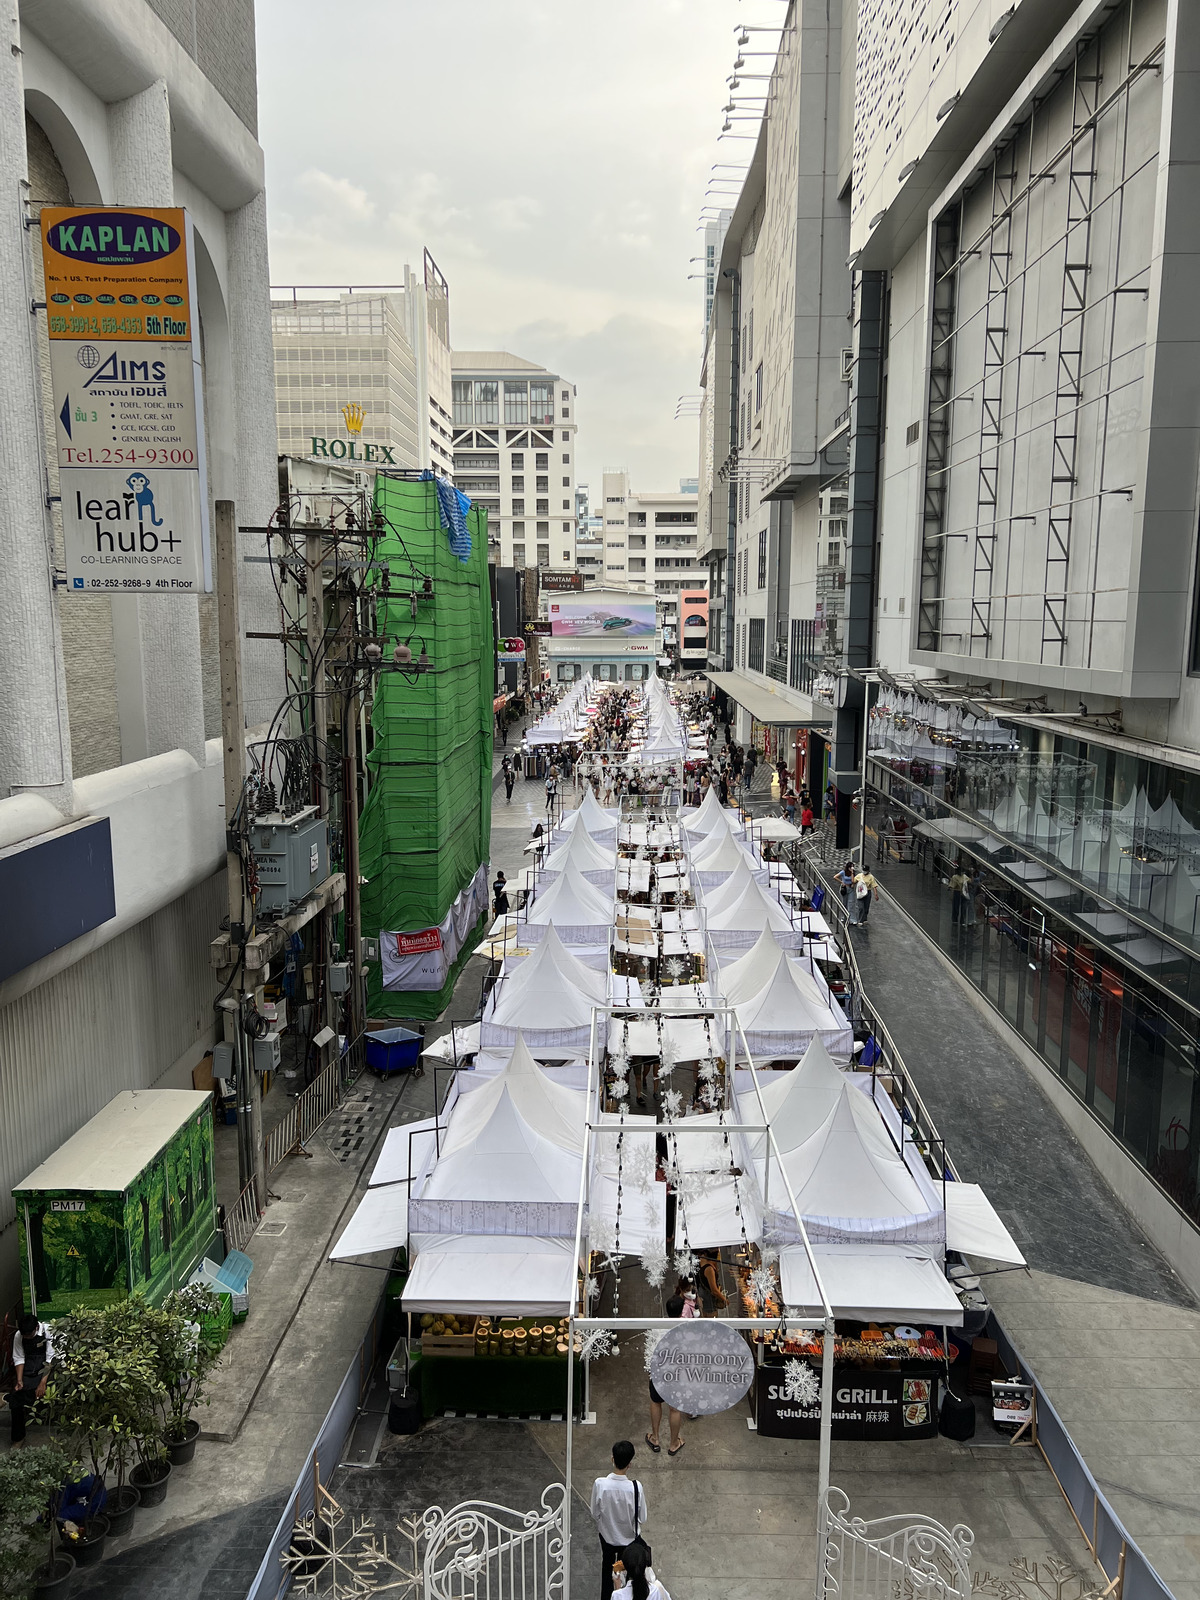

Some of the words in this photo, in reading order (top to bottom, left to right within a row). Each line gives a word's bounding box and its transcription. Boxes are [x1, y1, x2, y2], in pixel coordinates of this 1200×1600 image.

[58, 225, 170, 252] KAPLAN
[142, 295, 158, 303] SAT
[101, 317, 142, 334] 658-4353
[146, 315, 161, 335] 5th
[163, 316, 186, 336] Floor
[83, 351, 166, 388] AIMS
[89, 388, 128, 397] สถาบัน
[131, 384, 167, 397] เอมส์
[75, 406, 87, 422] ชั้น
[92, 411, 98, 422] 3
[310, 436, 397, 464] ROLEX
[96, 522, 182, 552] hub+
[81, 556, 148, 564] CO-LEARNING
[150, 556, 182, 565] SPACE
[155, 579, 169, 588] 4th
[171, 580, 193, 588] Floor
[52, 1201, 84, 1211] PM17
[658, 1348, 748, 1370] Harmony
[663, 1368, 682, 1382] of
[685, 1366, 748, 1384] Winter
[866, 1411, 889, 1422] 麻辣
